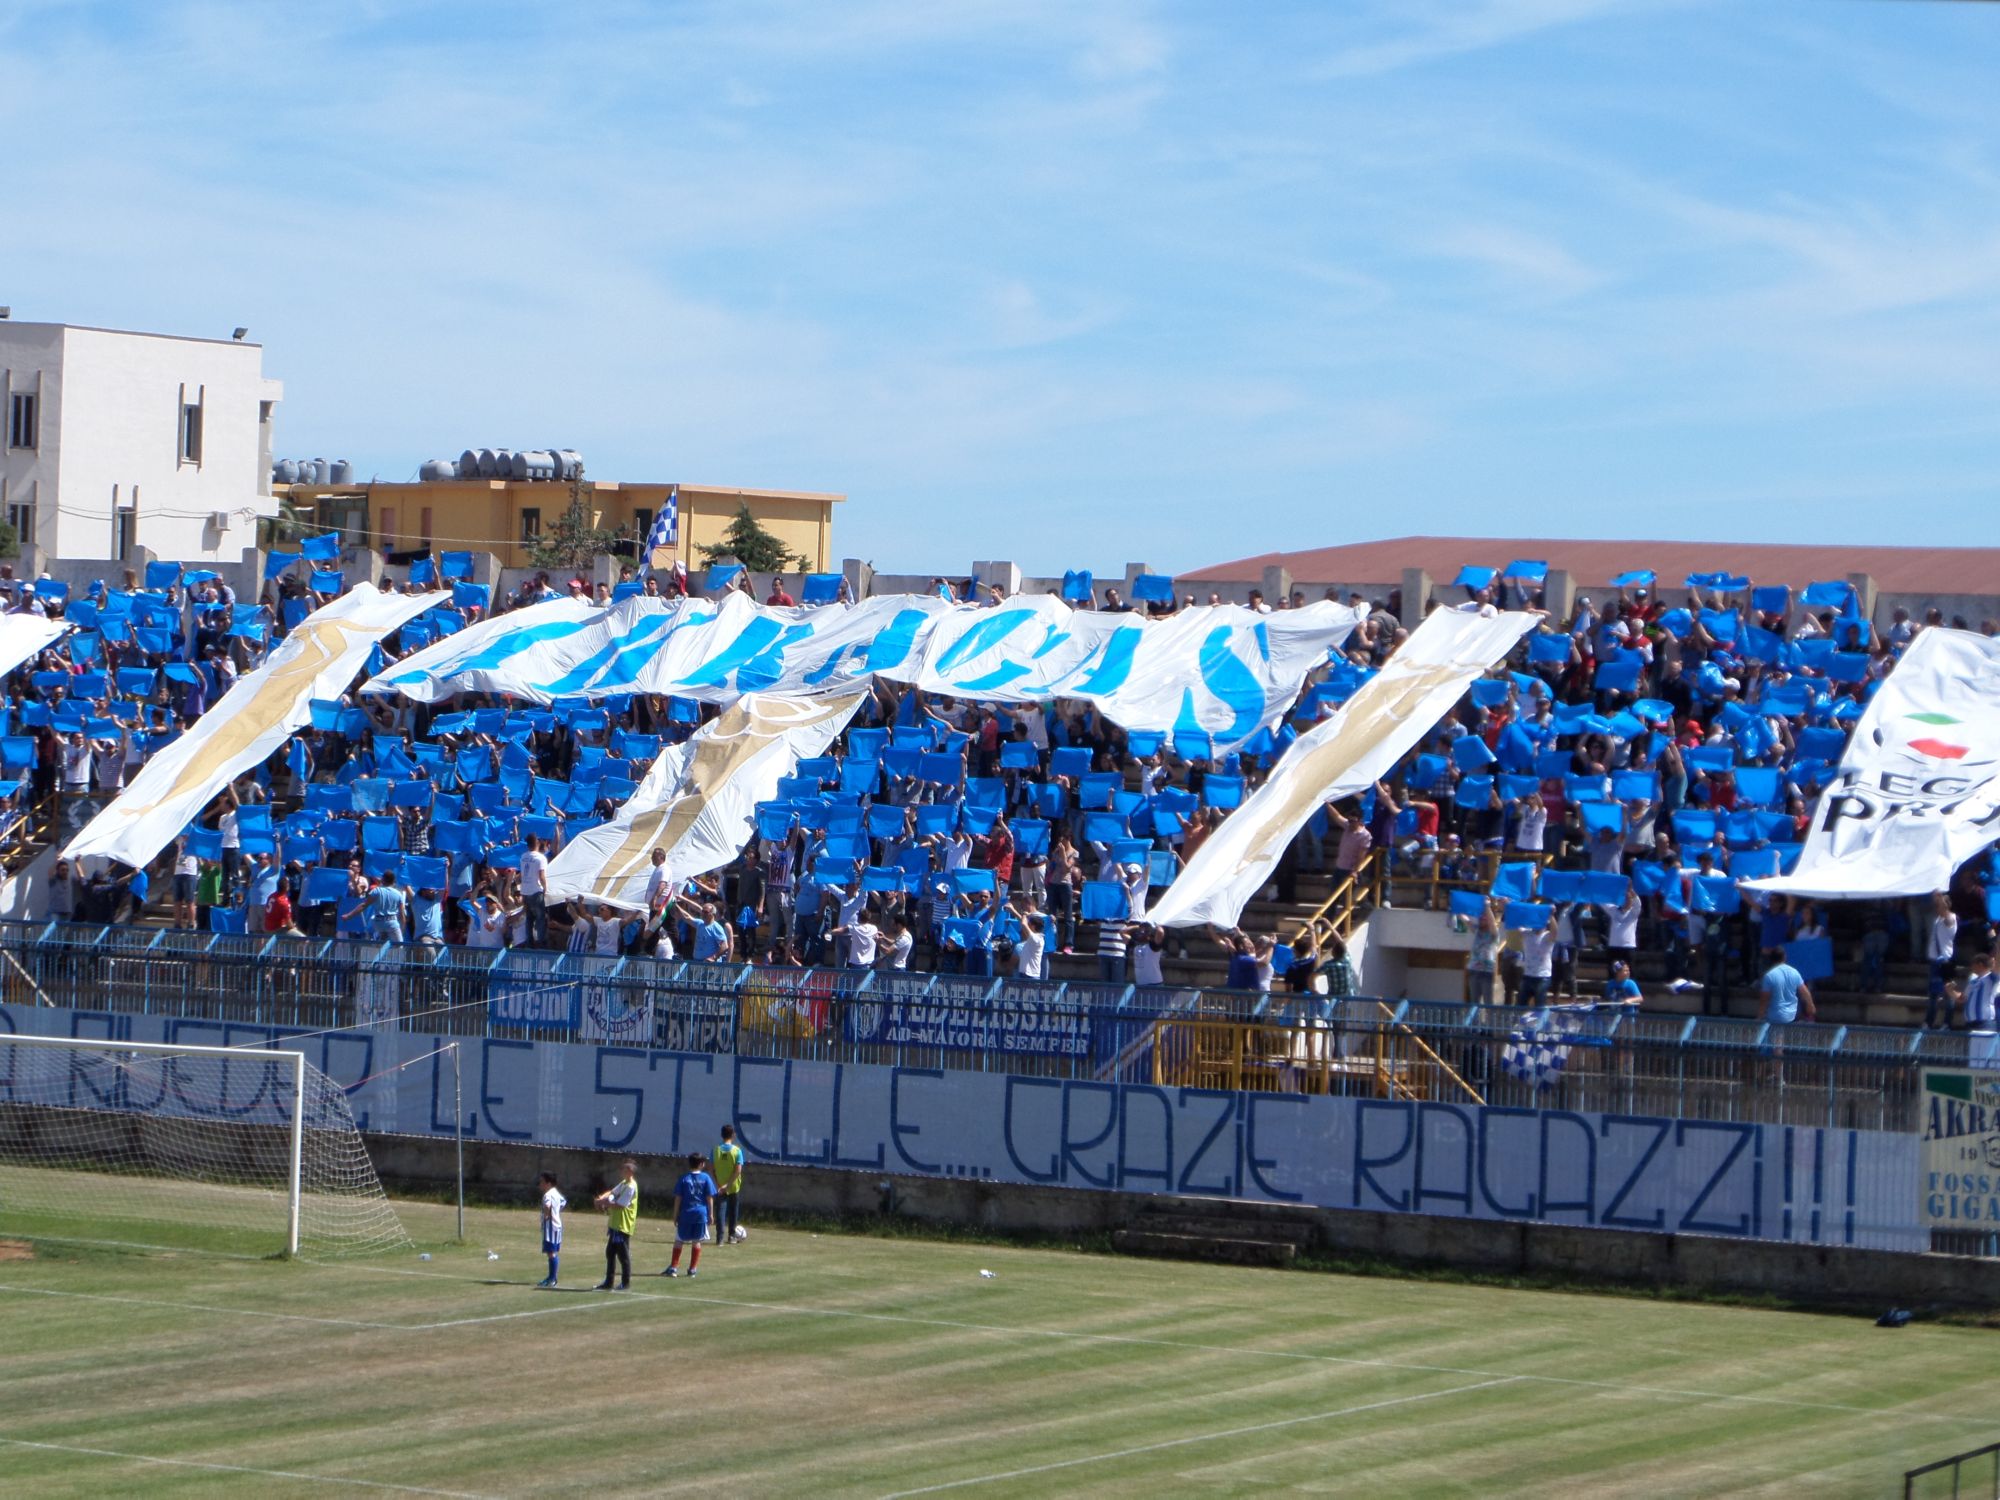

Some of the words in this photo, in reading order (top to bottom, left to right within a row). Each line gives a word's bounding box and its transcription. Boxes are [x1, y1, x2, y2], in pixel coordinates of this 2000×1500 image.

[889, 979, 1092, 1034] FEDELISSIMI
[1003, 1034, 1089, 1055] SEMPER
[431, 1036, 534, 1141] LE
[1003, 1075, 1310, 1201] GRAZIE
